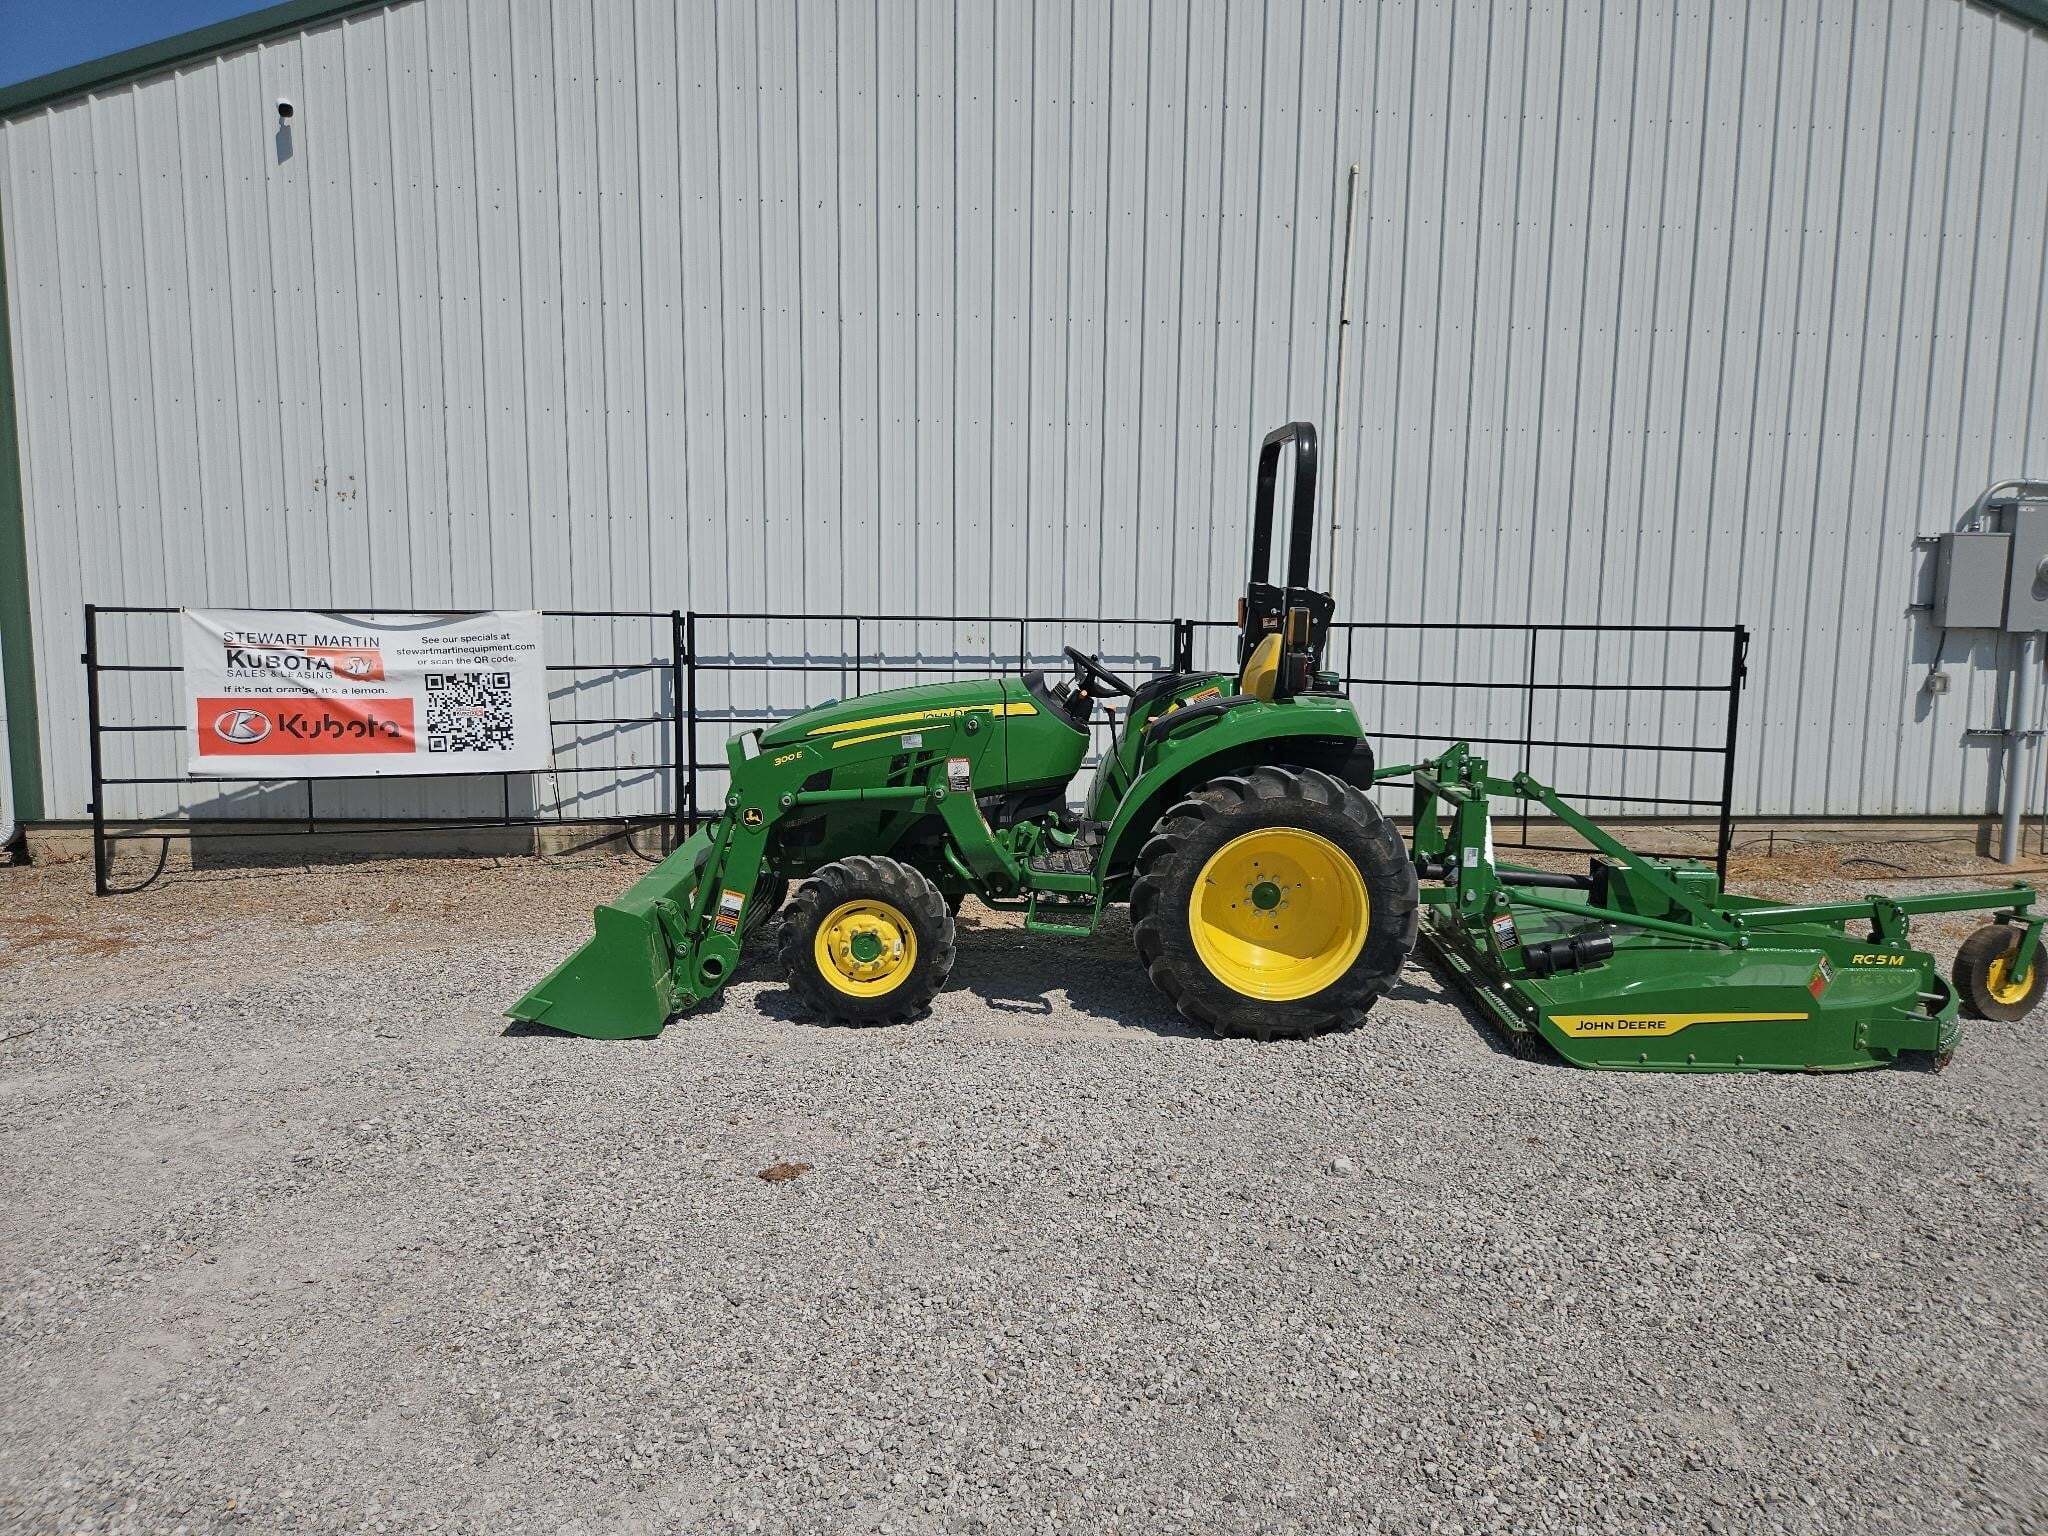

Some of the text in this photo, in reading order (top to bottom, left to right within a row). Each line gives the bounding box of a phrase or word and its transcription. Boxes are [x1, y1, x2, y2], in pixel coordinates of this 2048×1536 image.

[223, 631, 380, 647] STEWART MARTIN
[421, 636, 439, 644] See
[460, 633, 498, 645] specials
[396, 643, 536, 656] stewartmartinequipment.com
[227, 649, 331, 671] KUBOTA
[456, 657, 472, 665] the
[474, 656, 489, 664] QR
[491, 655, 517, 663] code.
[227, 669, 266, 678] SALES
[281, 671, 333, 680] LEASING
[276, 686, 318, 695] orange,
[351, 687, 388, 695] lemon.
[278, 713, 401, 739] Kubota
[1576, 1020, 1667, 1031] JOHN DEERE
